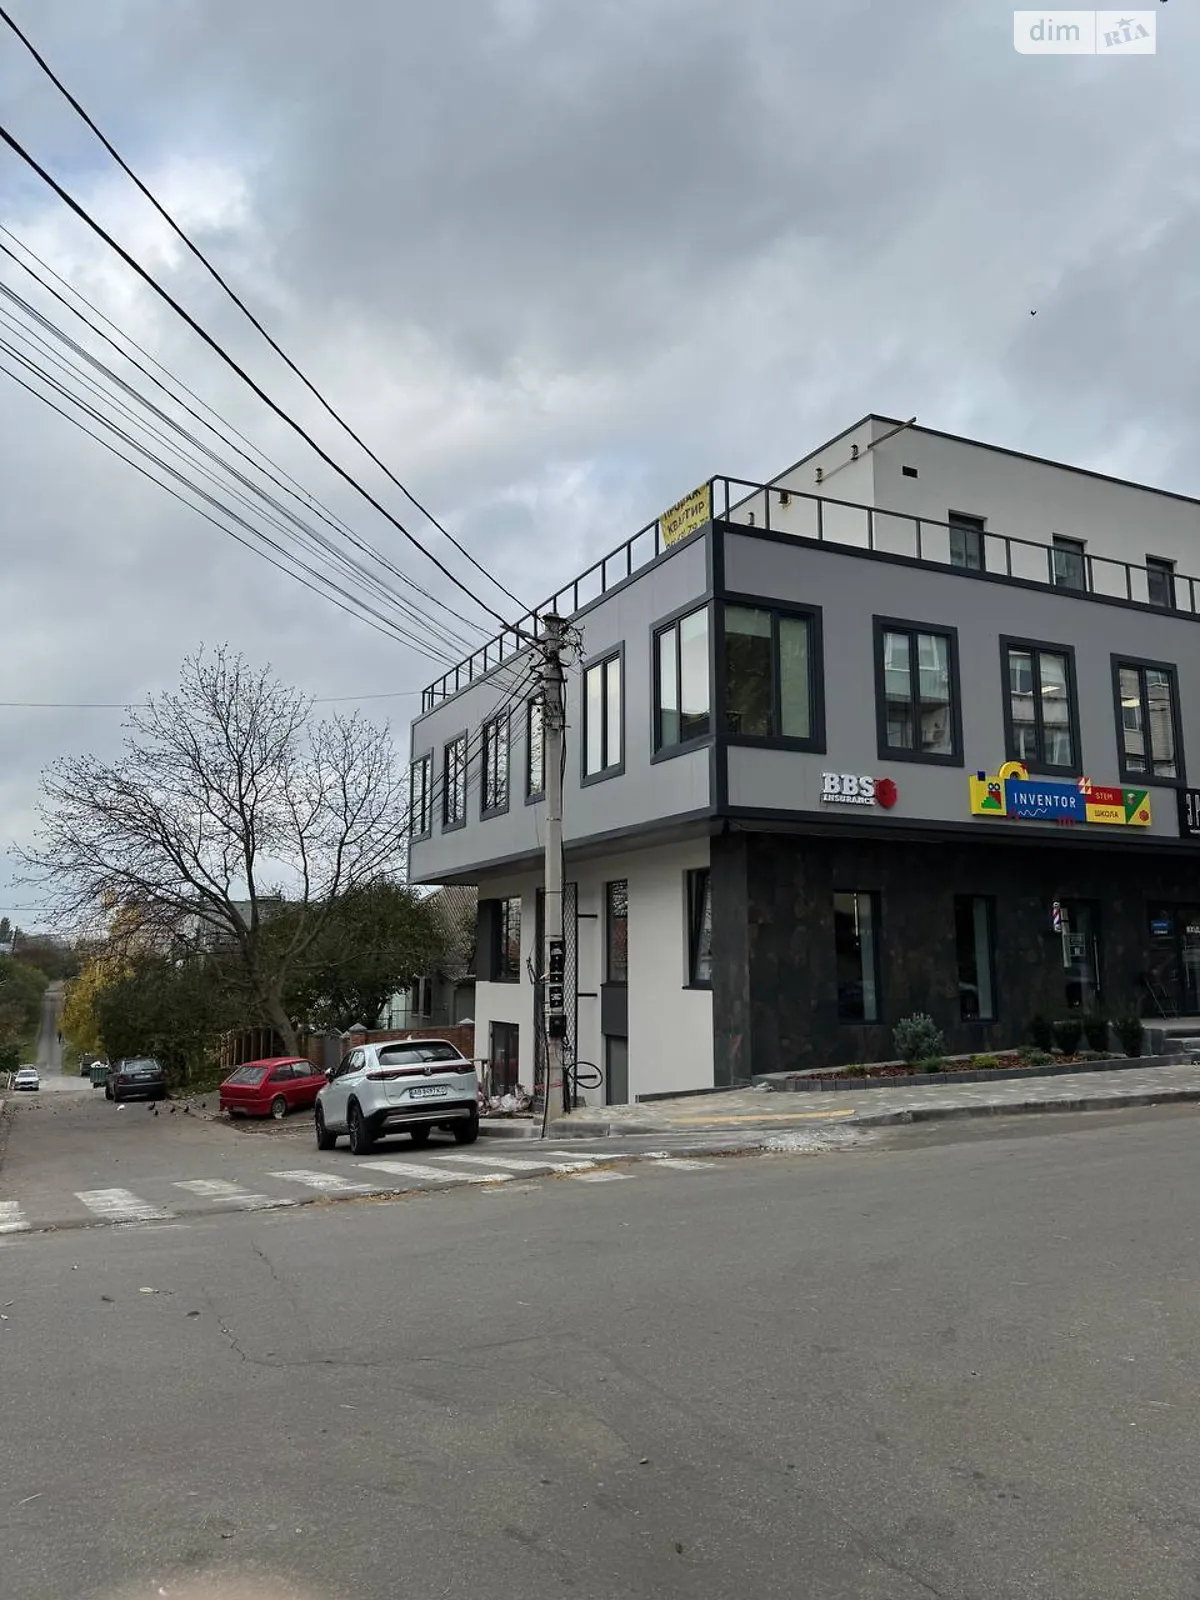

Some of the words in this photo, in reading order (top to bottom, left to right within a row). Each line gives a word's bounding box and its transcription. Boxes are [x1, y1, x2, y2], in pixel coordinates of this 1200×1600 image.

[822, 772, 875, 797] BBS
[823, 793, 876, 805] INSURANCE
[1013, 792, 1076, 809] INVENTOR
[1094, 791, 1113, 801] STEM
[1094, 809, 1120, 819] ШКОЛА
